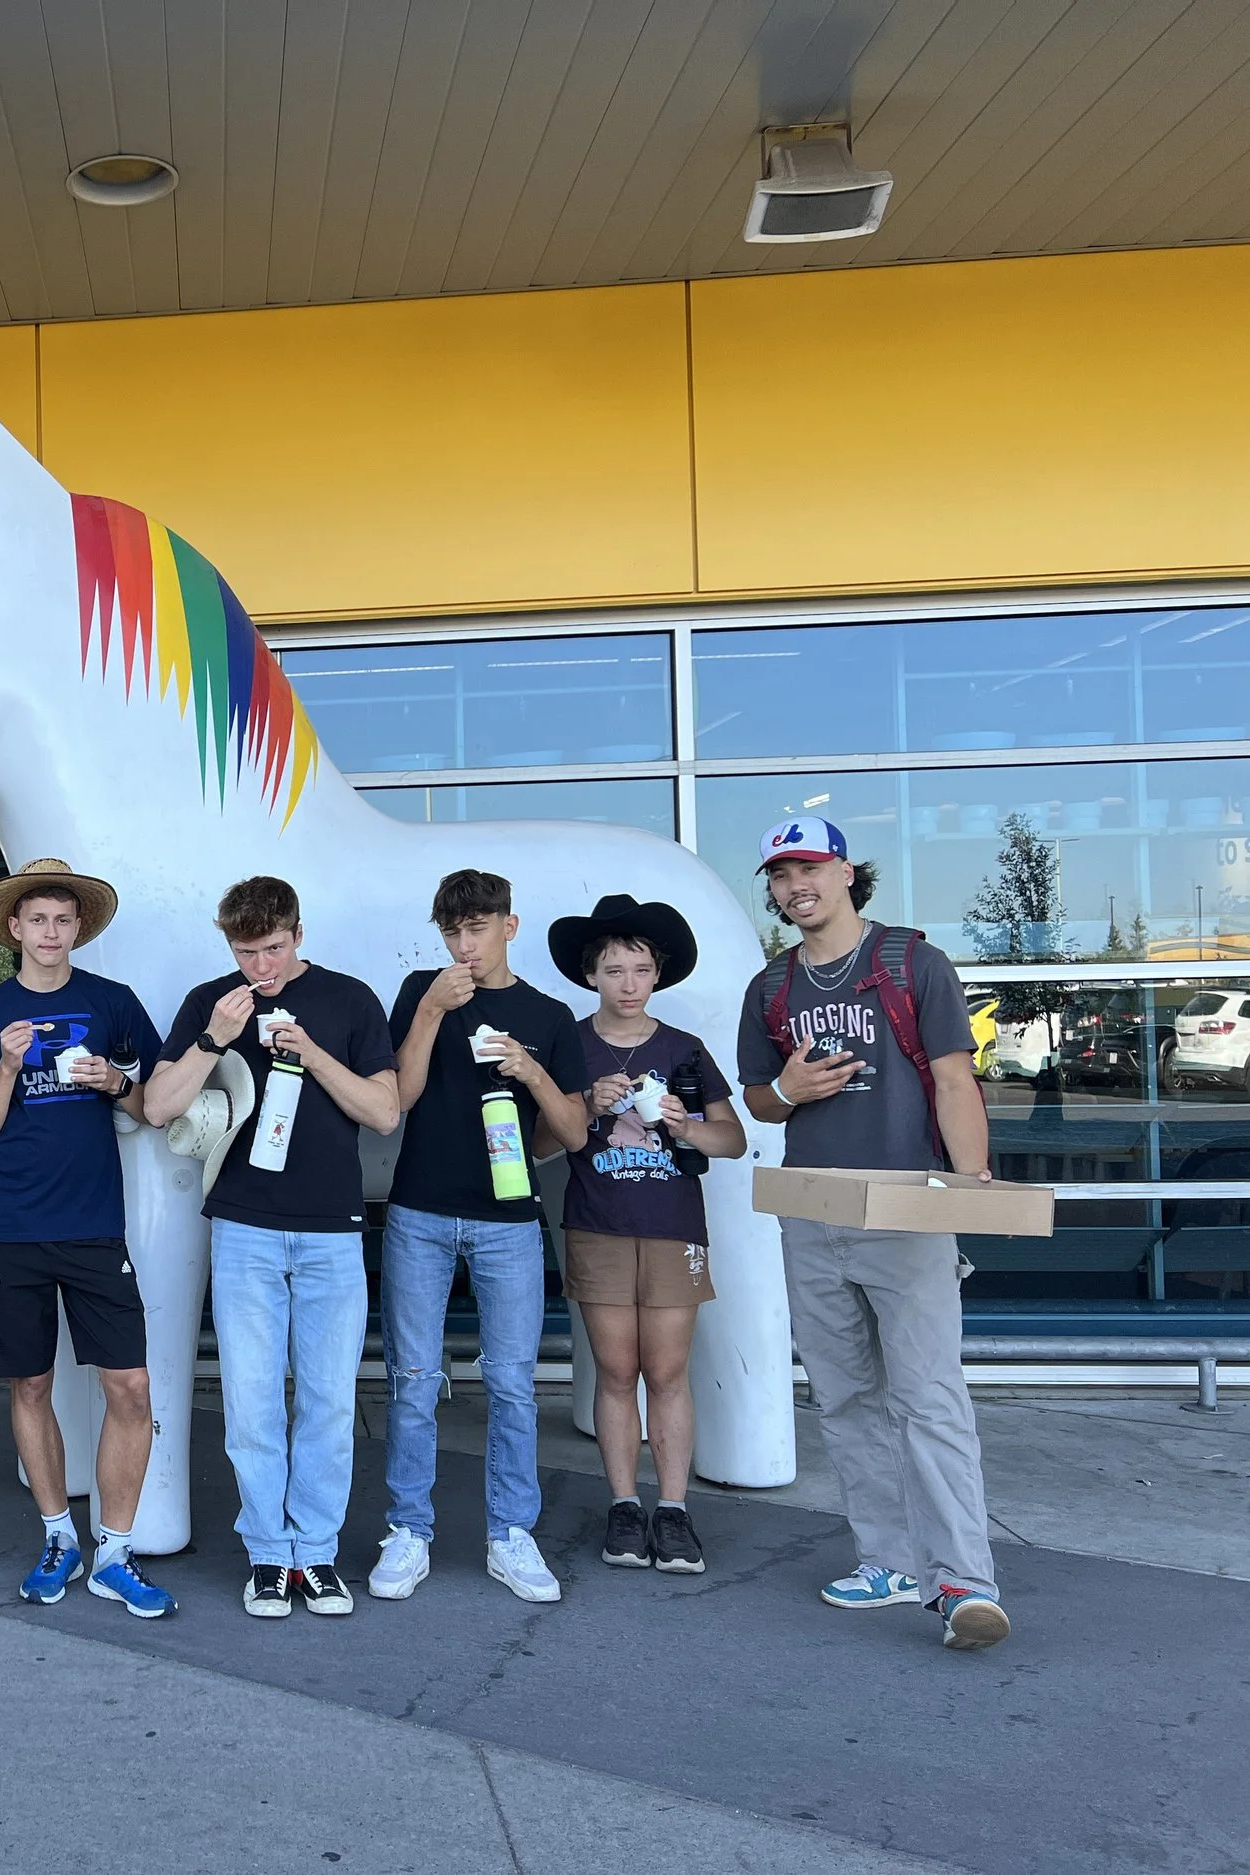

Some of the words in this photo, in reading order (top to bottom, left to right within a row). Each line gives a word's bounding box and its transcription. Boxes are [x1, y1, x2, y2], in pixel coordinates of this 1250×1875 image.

[25, 1082, 90, 1096] ARMOU
[592, 1147, 623, 1174] OLD
[611, 1169, 646, 1182] Vintage
[650, 1167, 669, 1181] dolls
